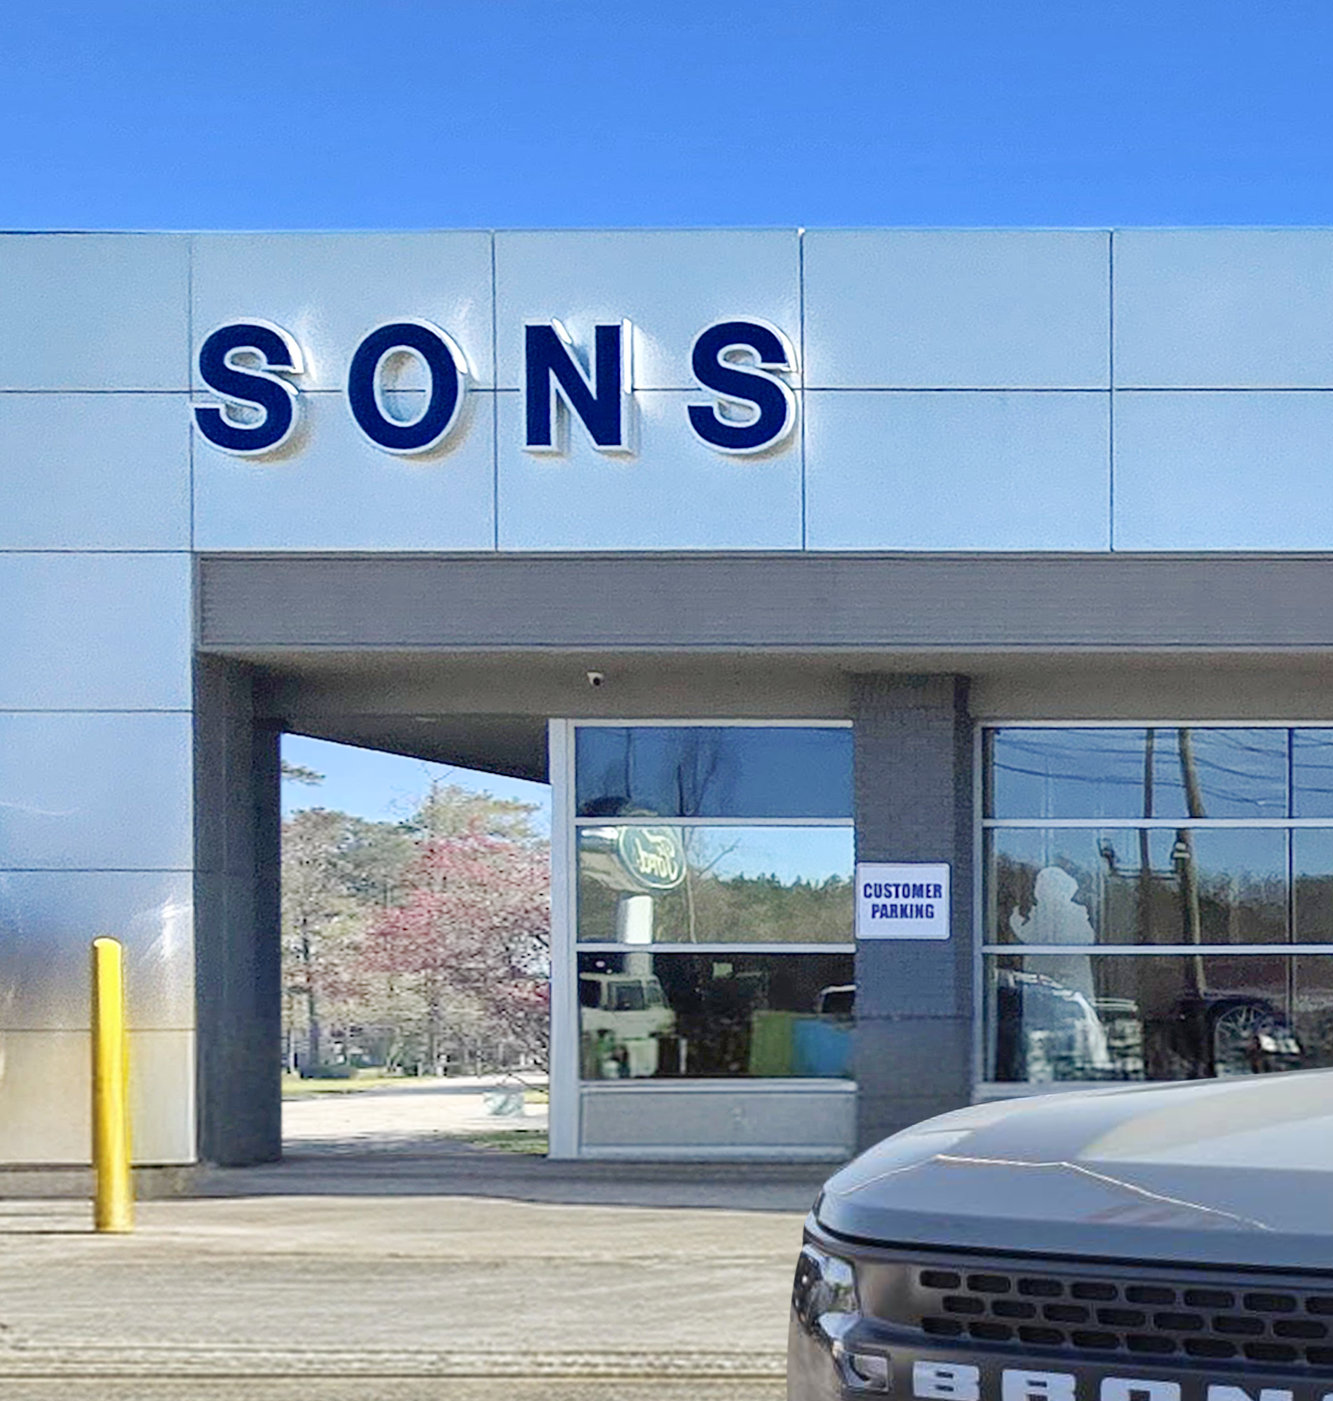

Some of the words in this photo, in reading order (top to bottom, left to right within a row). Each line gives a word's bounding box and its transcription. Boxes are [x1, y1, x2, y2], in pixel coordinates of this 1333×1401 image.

[193, 319, 800, 454] SONS
[863, 882, 943, 899] CUSTOMER
[871, 903, 935, 919] PARKING
